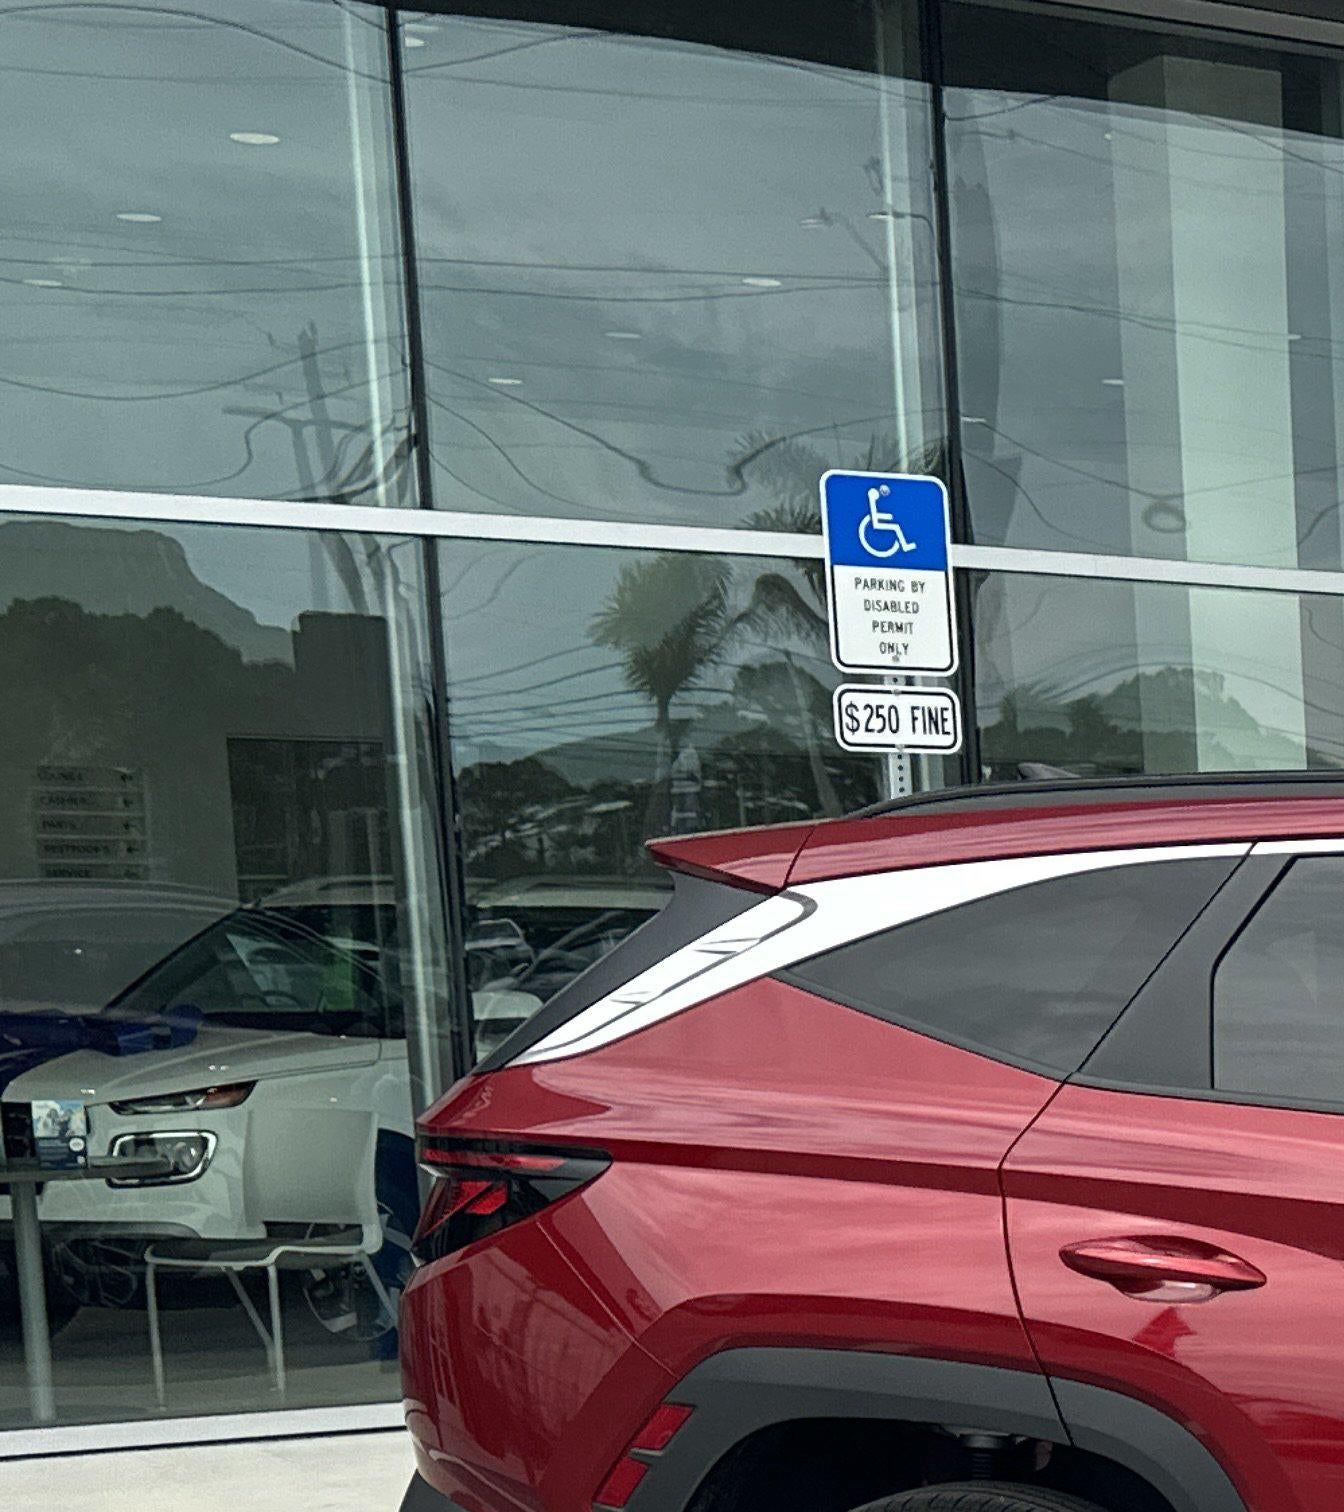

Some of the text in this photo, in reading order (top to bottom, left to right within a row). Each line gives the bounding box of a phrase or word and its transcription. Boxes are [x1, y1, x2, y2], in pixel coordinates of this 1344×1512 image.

[854, 577, 926, 593] PARKING BY
[863, 599, 920, 614] DISABLED
[872, 620, 914, 635] PERMIT
[879, 641, 909, 656] ONLY
[845, 701, 951, 736] $250 FINE
